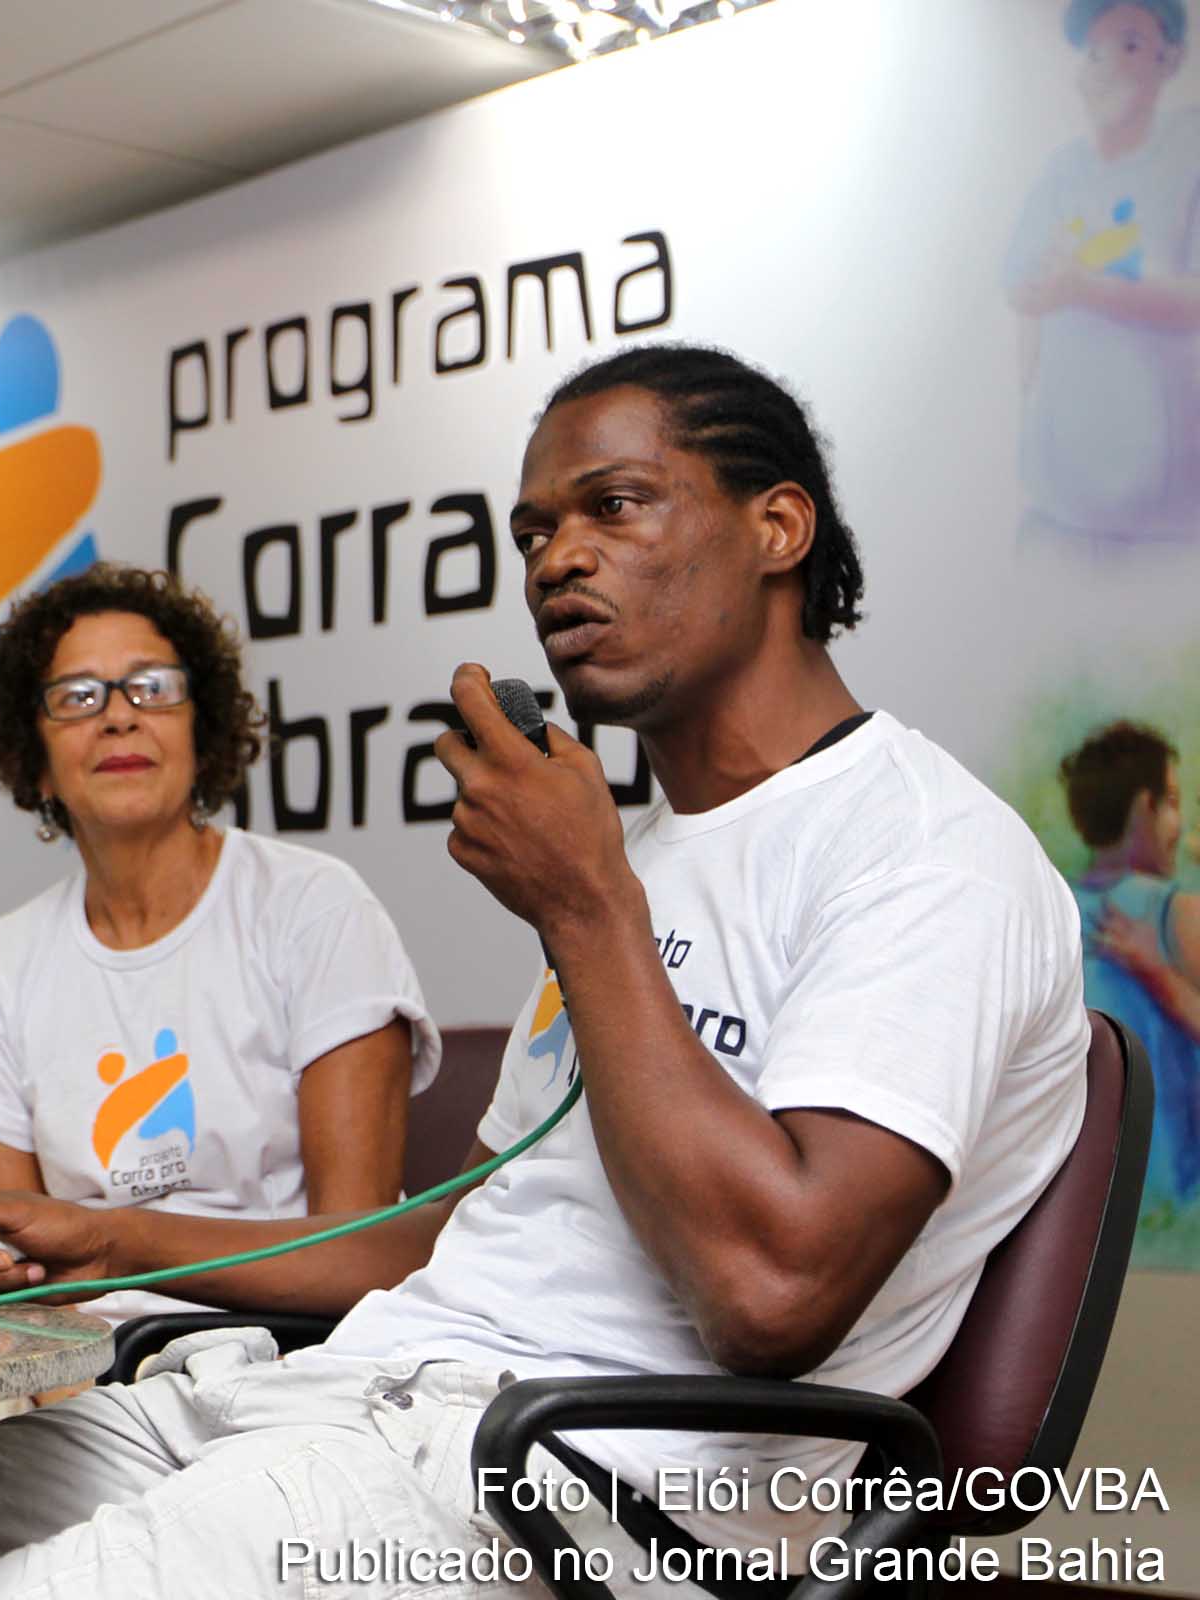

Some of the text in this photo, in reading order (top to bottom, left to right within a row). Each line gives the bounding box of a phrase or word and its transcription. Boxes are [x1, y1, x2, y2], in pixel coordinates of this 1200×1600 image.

[168, 230, 673, 463] programa
[111, 1160, 186, 1186] Corra pro
